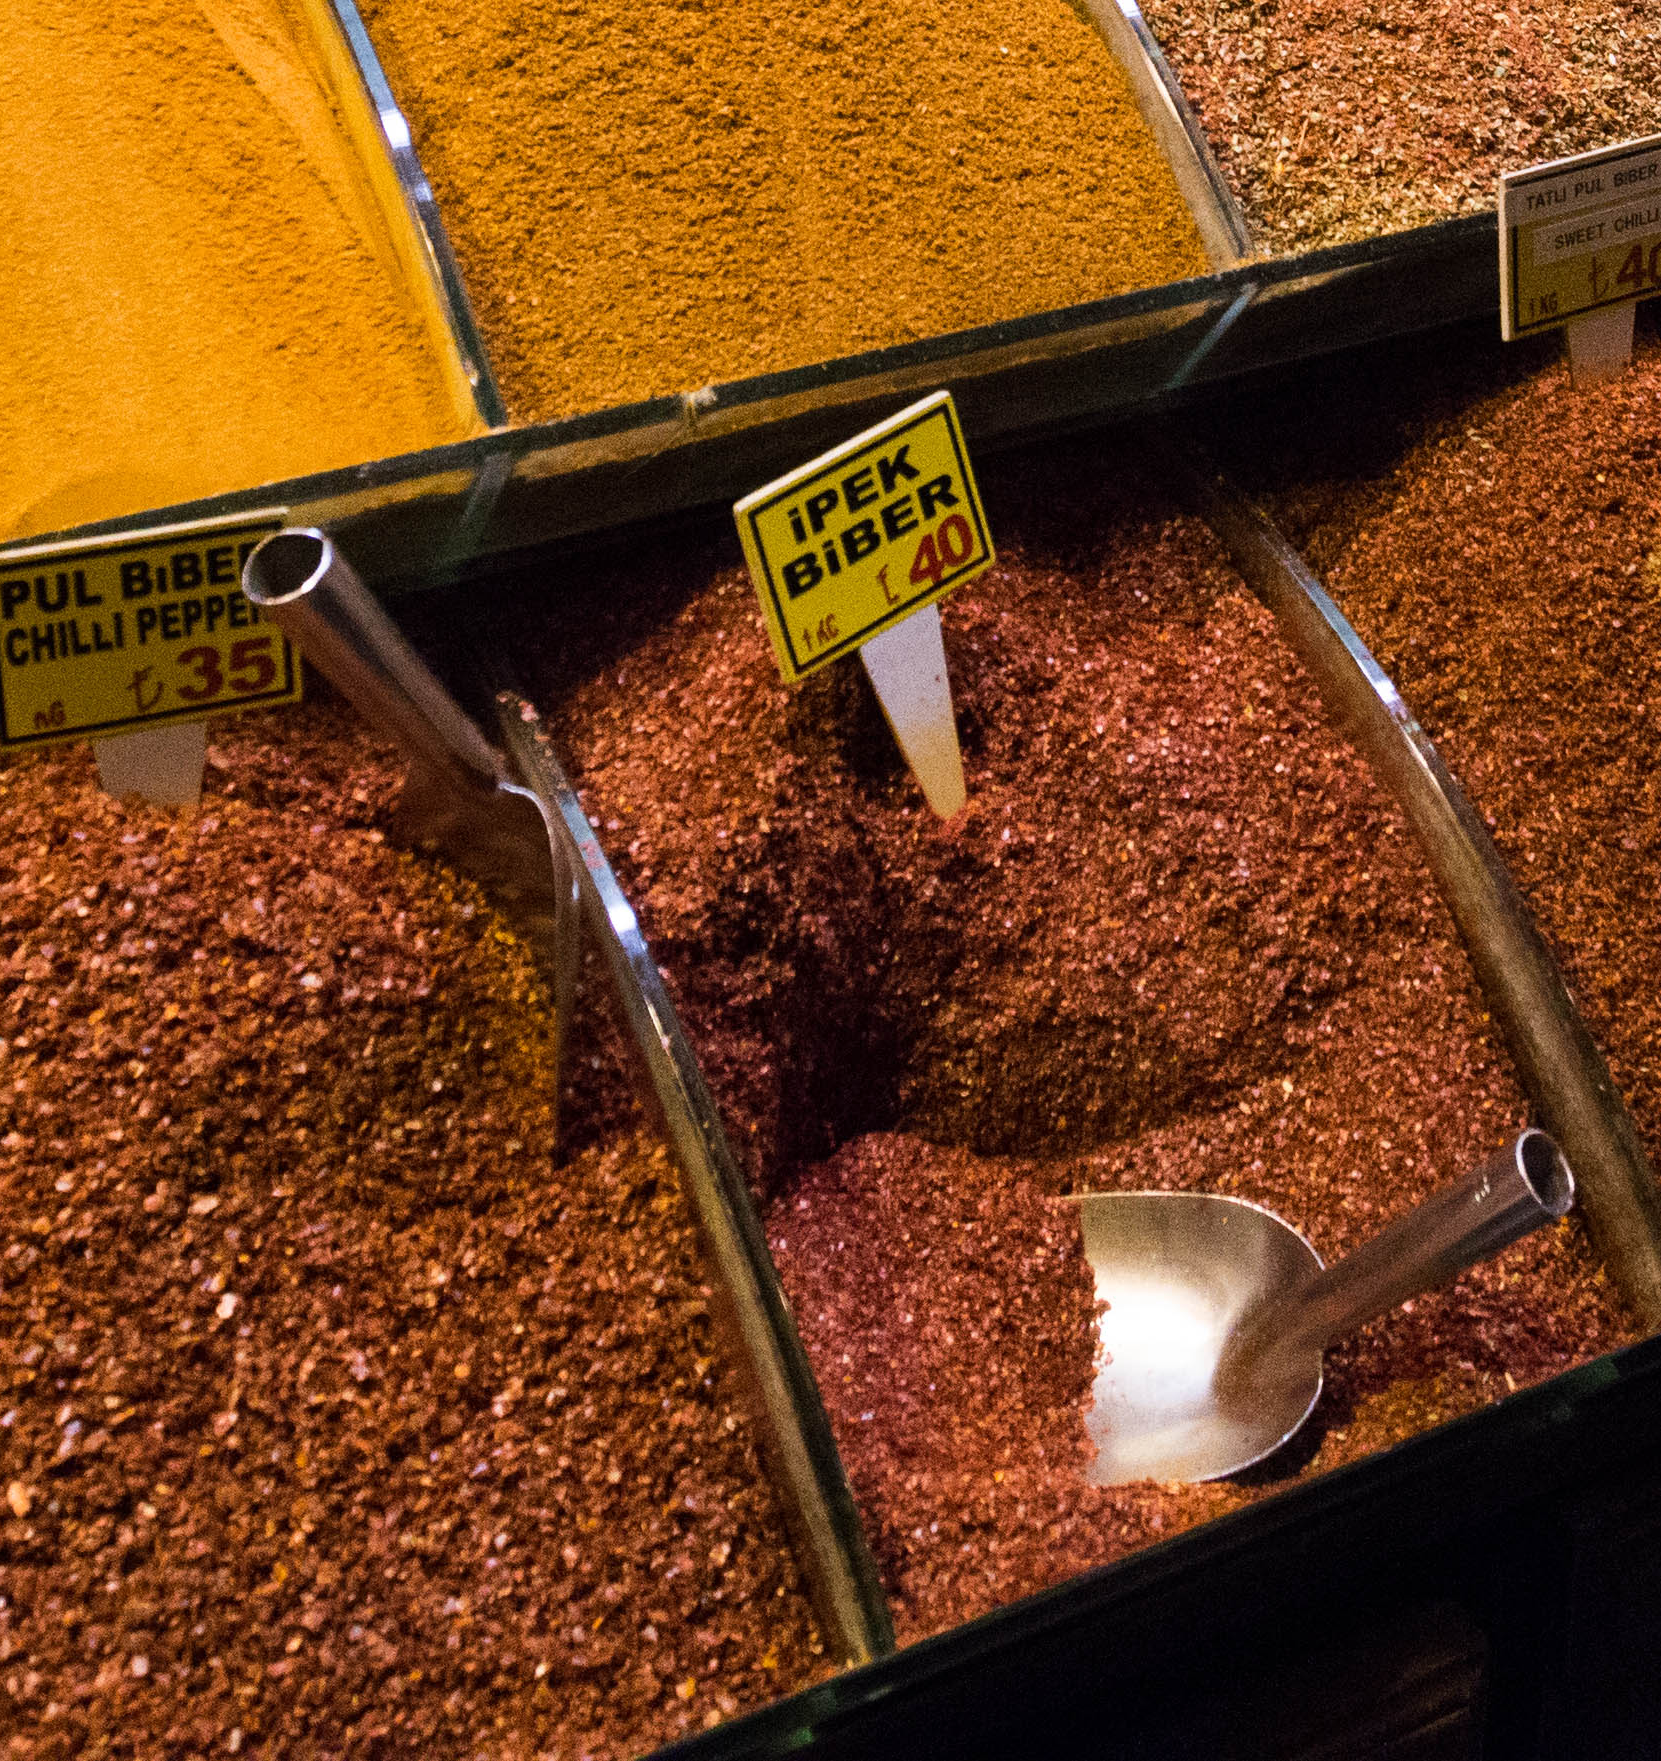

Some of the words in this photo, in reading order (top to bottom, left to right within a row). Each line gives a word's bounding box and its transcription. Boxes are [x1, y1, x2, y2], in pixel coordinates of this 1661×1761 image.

[1525, 189, 1568, 211] TATLI
[1573, 179, 1605, 199] PUL
[1553, 224, 1605, 250] SWEET
[1613, 207, 1661, 234] CHILLI
[907, 513, 975, 590] 40
[4, 613, 126, 668] CHILLI
[174, 636, 278, 703] 35
